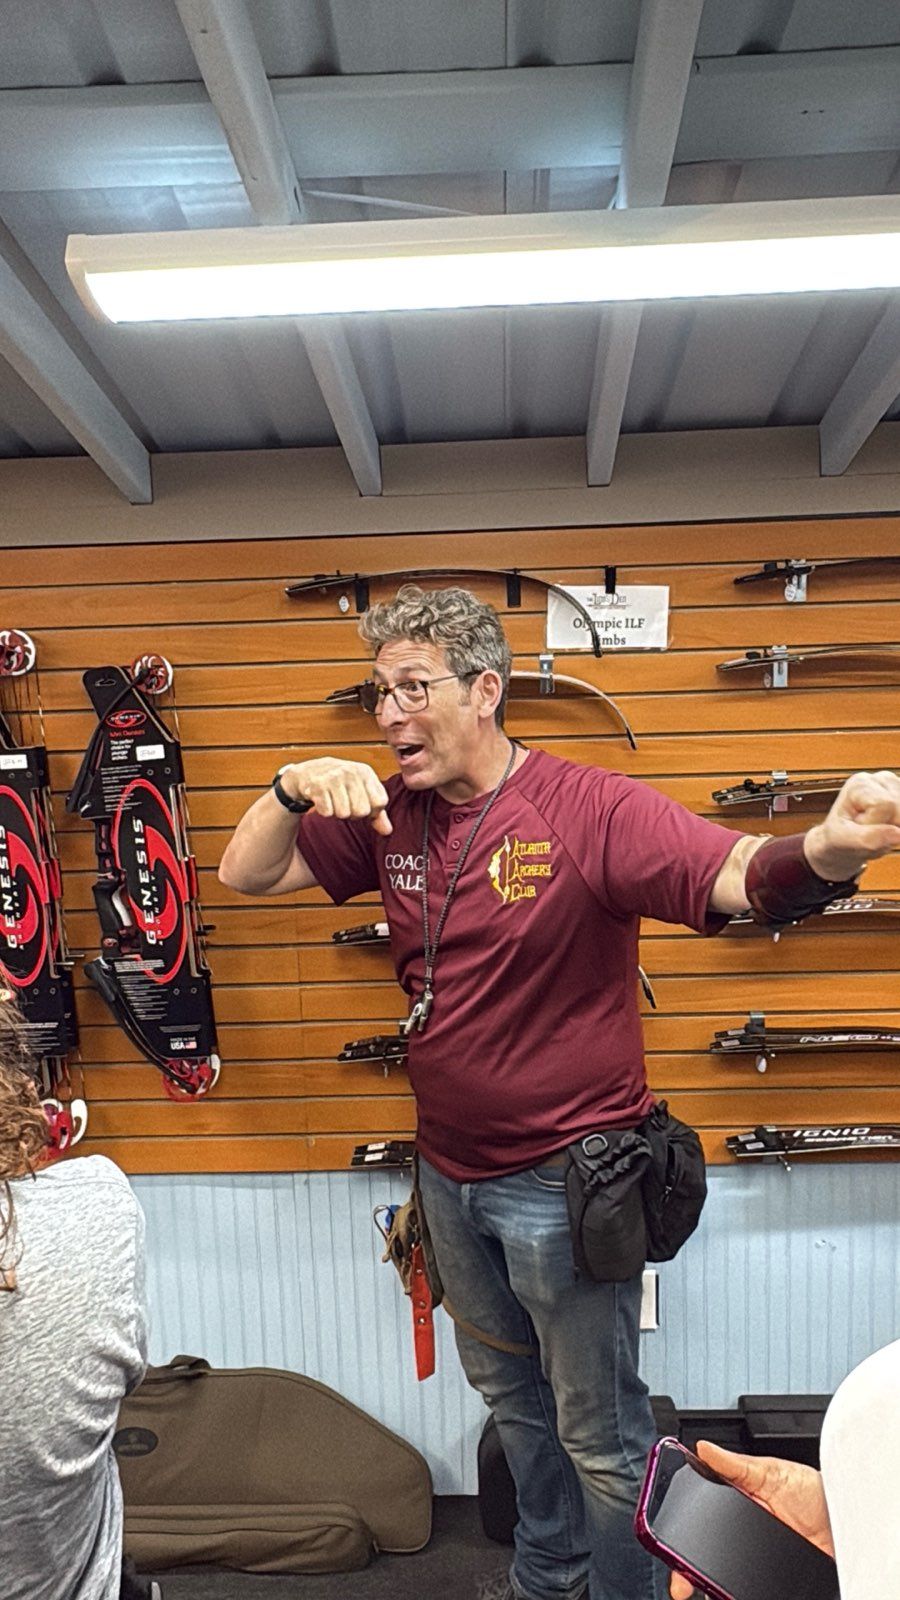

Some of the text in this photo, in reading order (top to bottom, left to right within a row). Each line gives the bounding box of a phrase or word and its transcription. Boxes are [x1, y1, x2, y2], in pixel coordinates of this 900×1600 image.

[624, 618, 645, 629] ILF
[591, 633, 627, 646] imbs
[133, 818, 157, 945] GENESIS
[389, 873, 426, 891] YALE
[170, 1041, 186, 1051] USA
[793, 1127, 871, 1137] IGNIO
